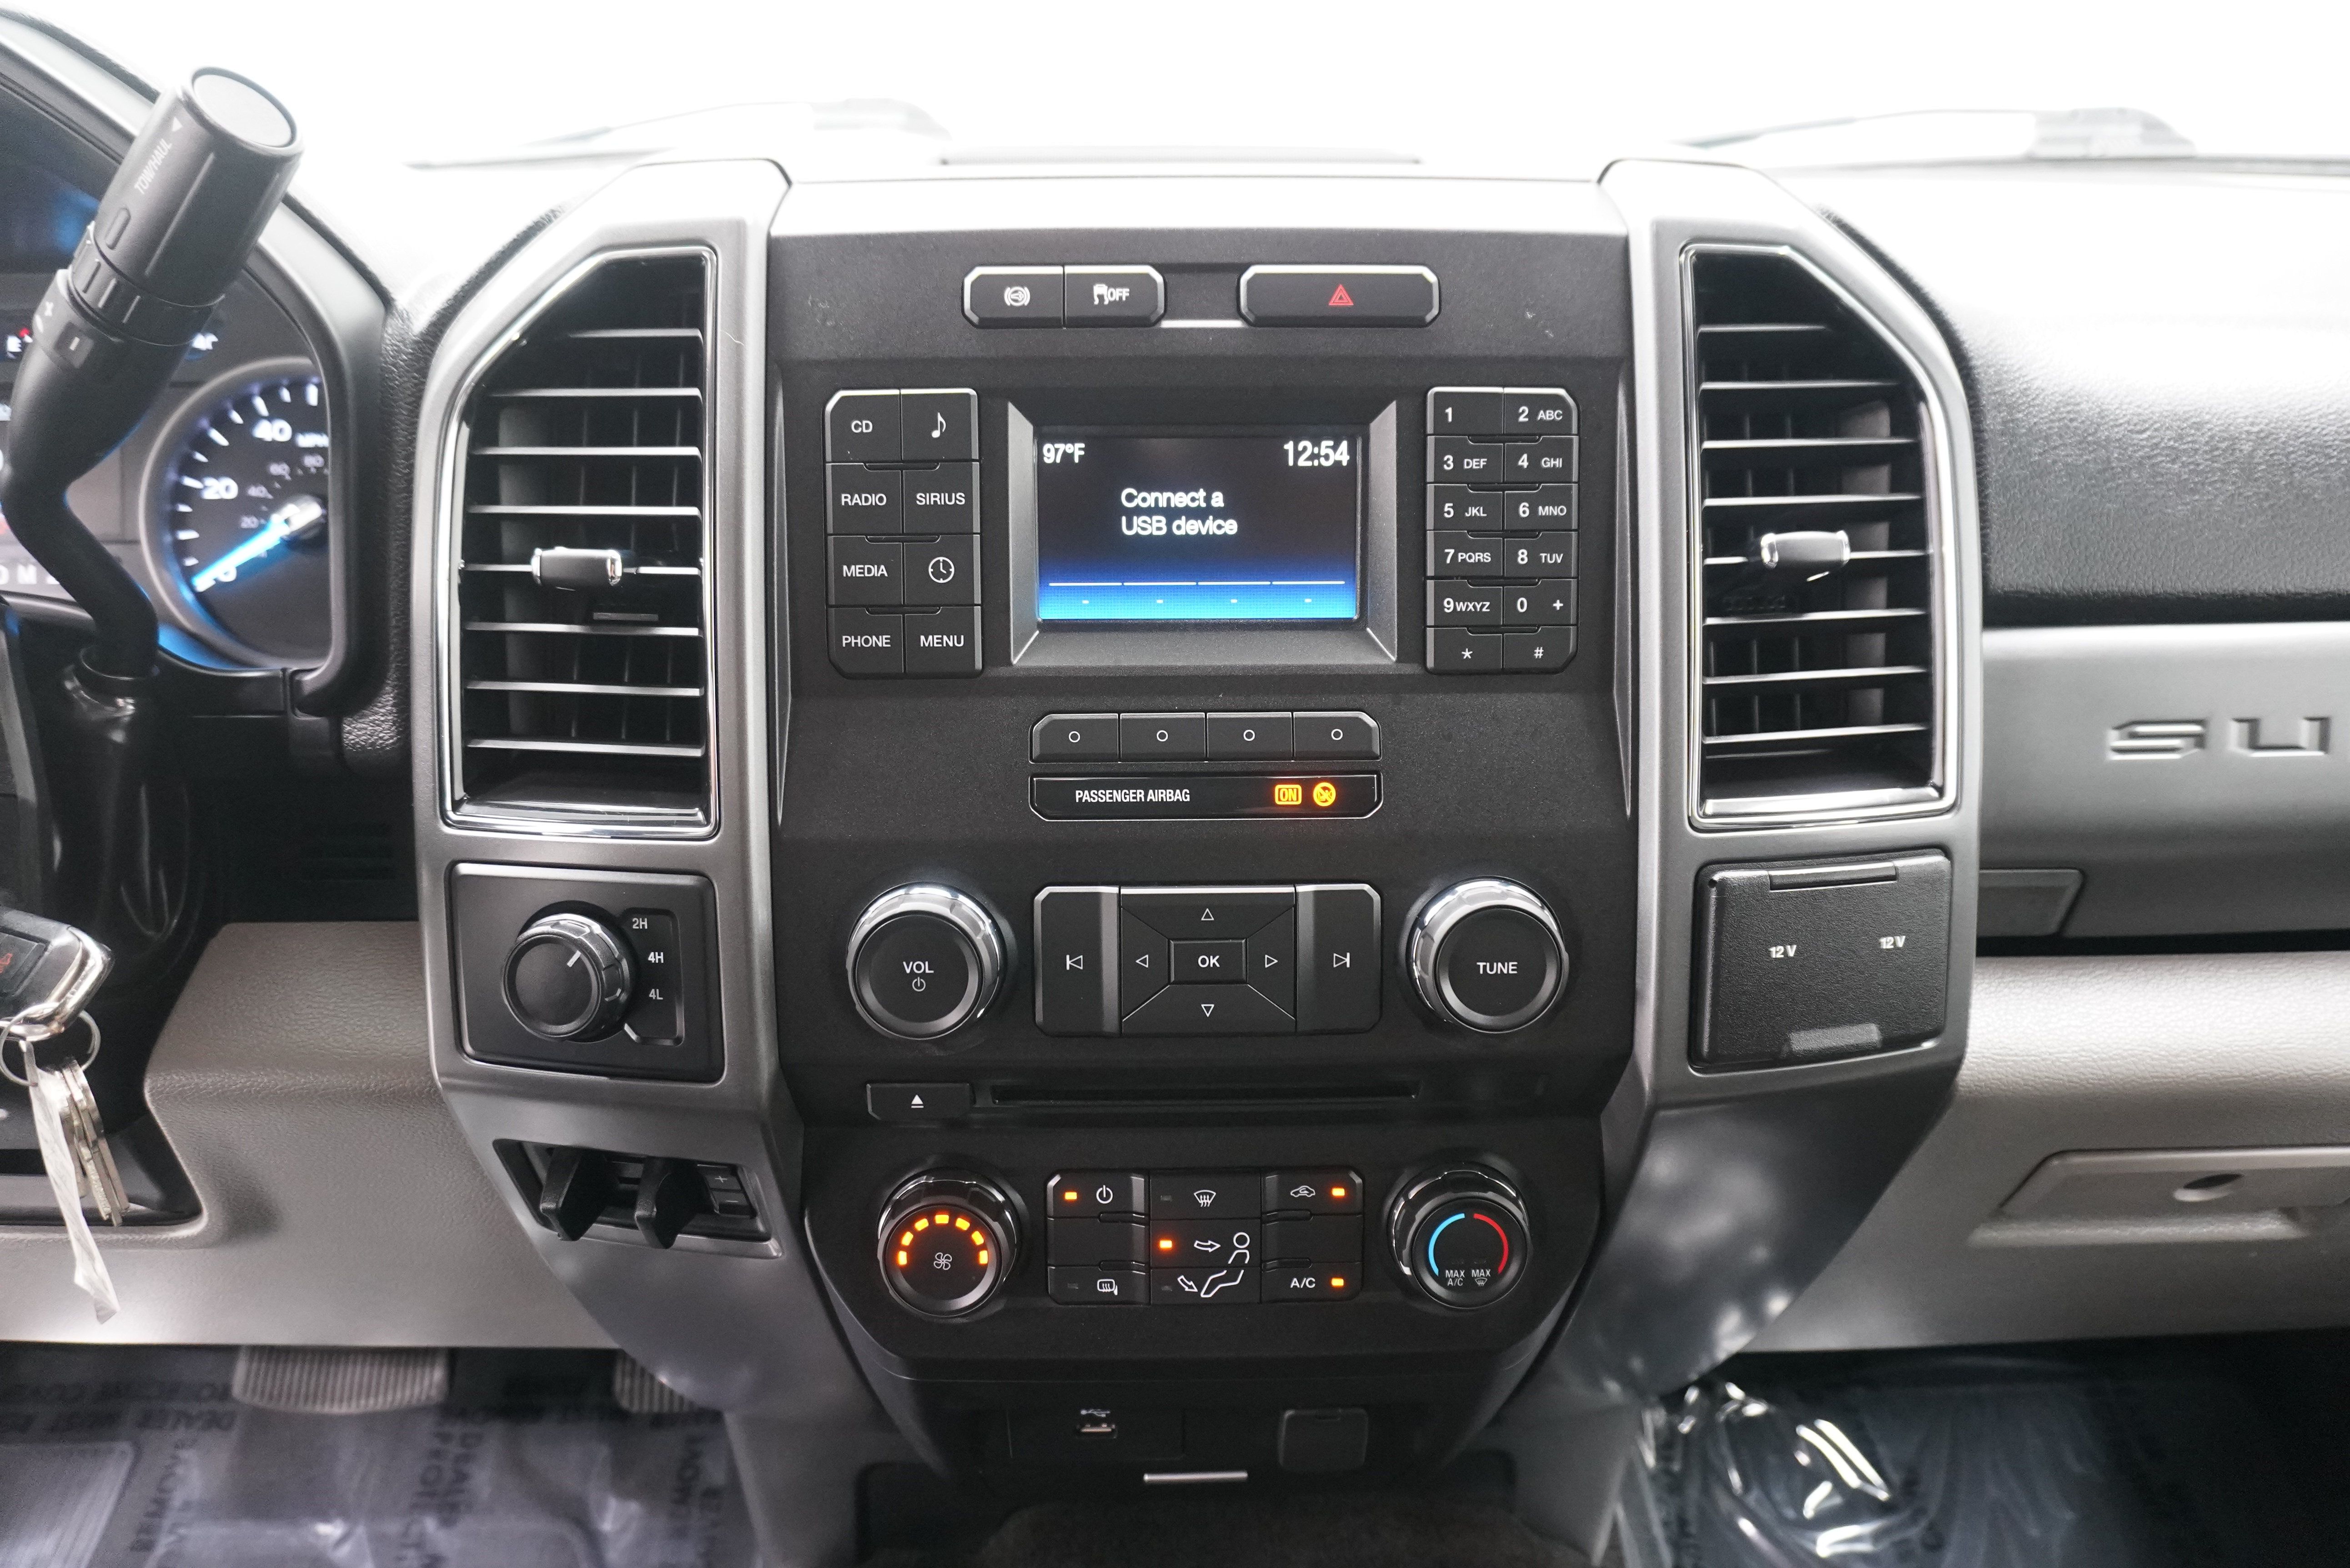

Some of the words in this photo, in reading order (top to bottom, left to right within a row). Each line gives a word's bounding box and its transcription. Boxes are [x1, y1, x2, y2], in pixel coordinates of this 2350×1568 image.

[134, 138, 172, 194] TOW/HAUL
[1107, 287, 1130, 301] OFF
[1445, 407, 1452, 422] 1
[1518, 406, 1529, 422] 2
[1537, 410, 1563, 420] ABC
[252, 418, 292, 442] 40
[851, 420, 873, 433] CD
[1283, 440, 1350, 467] 12:54
[1518, 453, 1529, 468] 4
[1541, 457, 1562, 468] GHI
[1443, 455, 1454, 470] 3
[1464, 458, 1487, 469] DEF
[202, 477, 239, 499] 20
[841, 493, 887, 506] RADIO
[916, 492, 965, 505] SIRIUS
[1121, 487, 1206, 508] Connect
[1210, 491, 1225, 508] a
[1444, 503, 1454, 518] 5
[1465, 506, 1487, 517] JKL
[1519, 502, 1530, 518] 6
[1538, 505, 1567, 516] MNO
[1121, 515, 1167, 536] USB
[1172, 515, 1238, 535] device
[1517, 549, 1528, 564] 8
[1540, 553, 1563, 563] TUV
[843, 564, 888, 577] MEDIA
[1517, 597, 1527, 613] 0
[842, 635, 891, 647] PHONE
[920, 635, 964, 647] MENU
[1075, 789, 1145, 803] PASSENGER
[1146, 789, 1190, 802] AIRBAG
[1279, 788, 1297, 802] ON
[632, 917, 648, 929] 2H
[648, 951, 664, 963] 4H
[1198, 955, 1220, 968] OK
[903, 961, 934, 974] VOL
[1476, 962, 1518, 975] TUNE
[649, 989, 663, 1000] 4L
[1446, 1270, 1465, 1278] MAX
[1471, 1269, 1491, 1277] MAX
[1290, 1277, 1316, 1288] A/C
[1447, 1278, 1463, 1286] A/C
